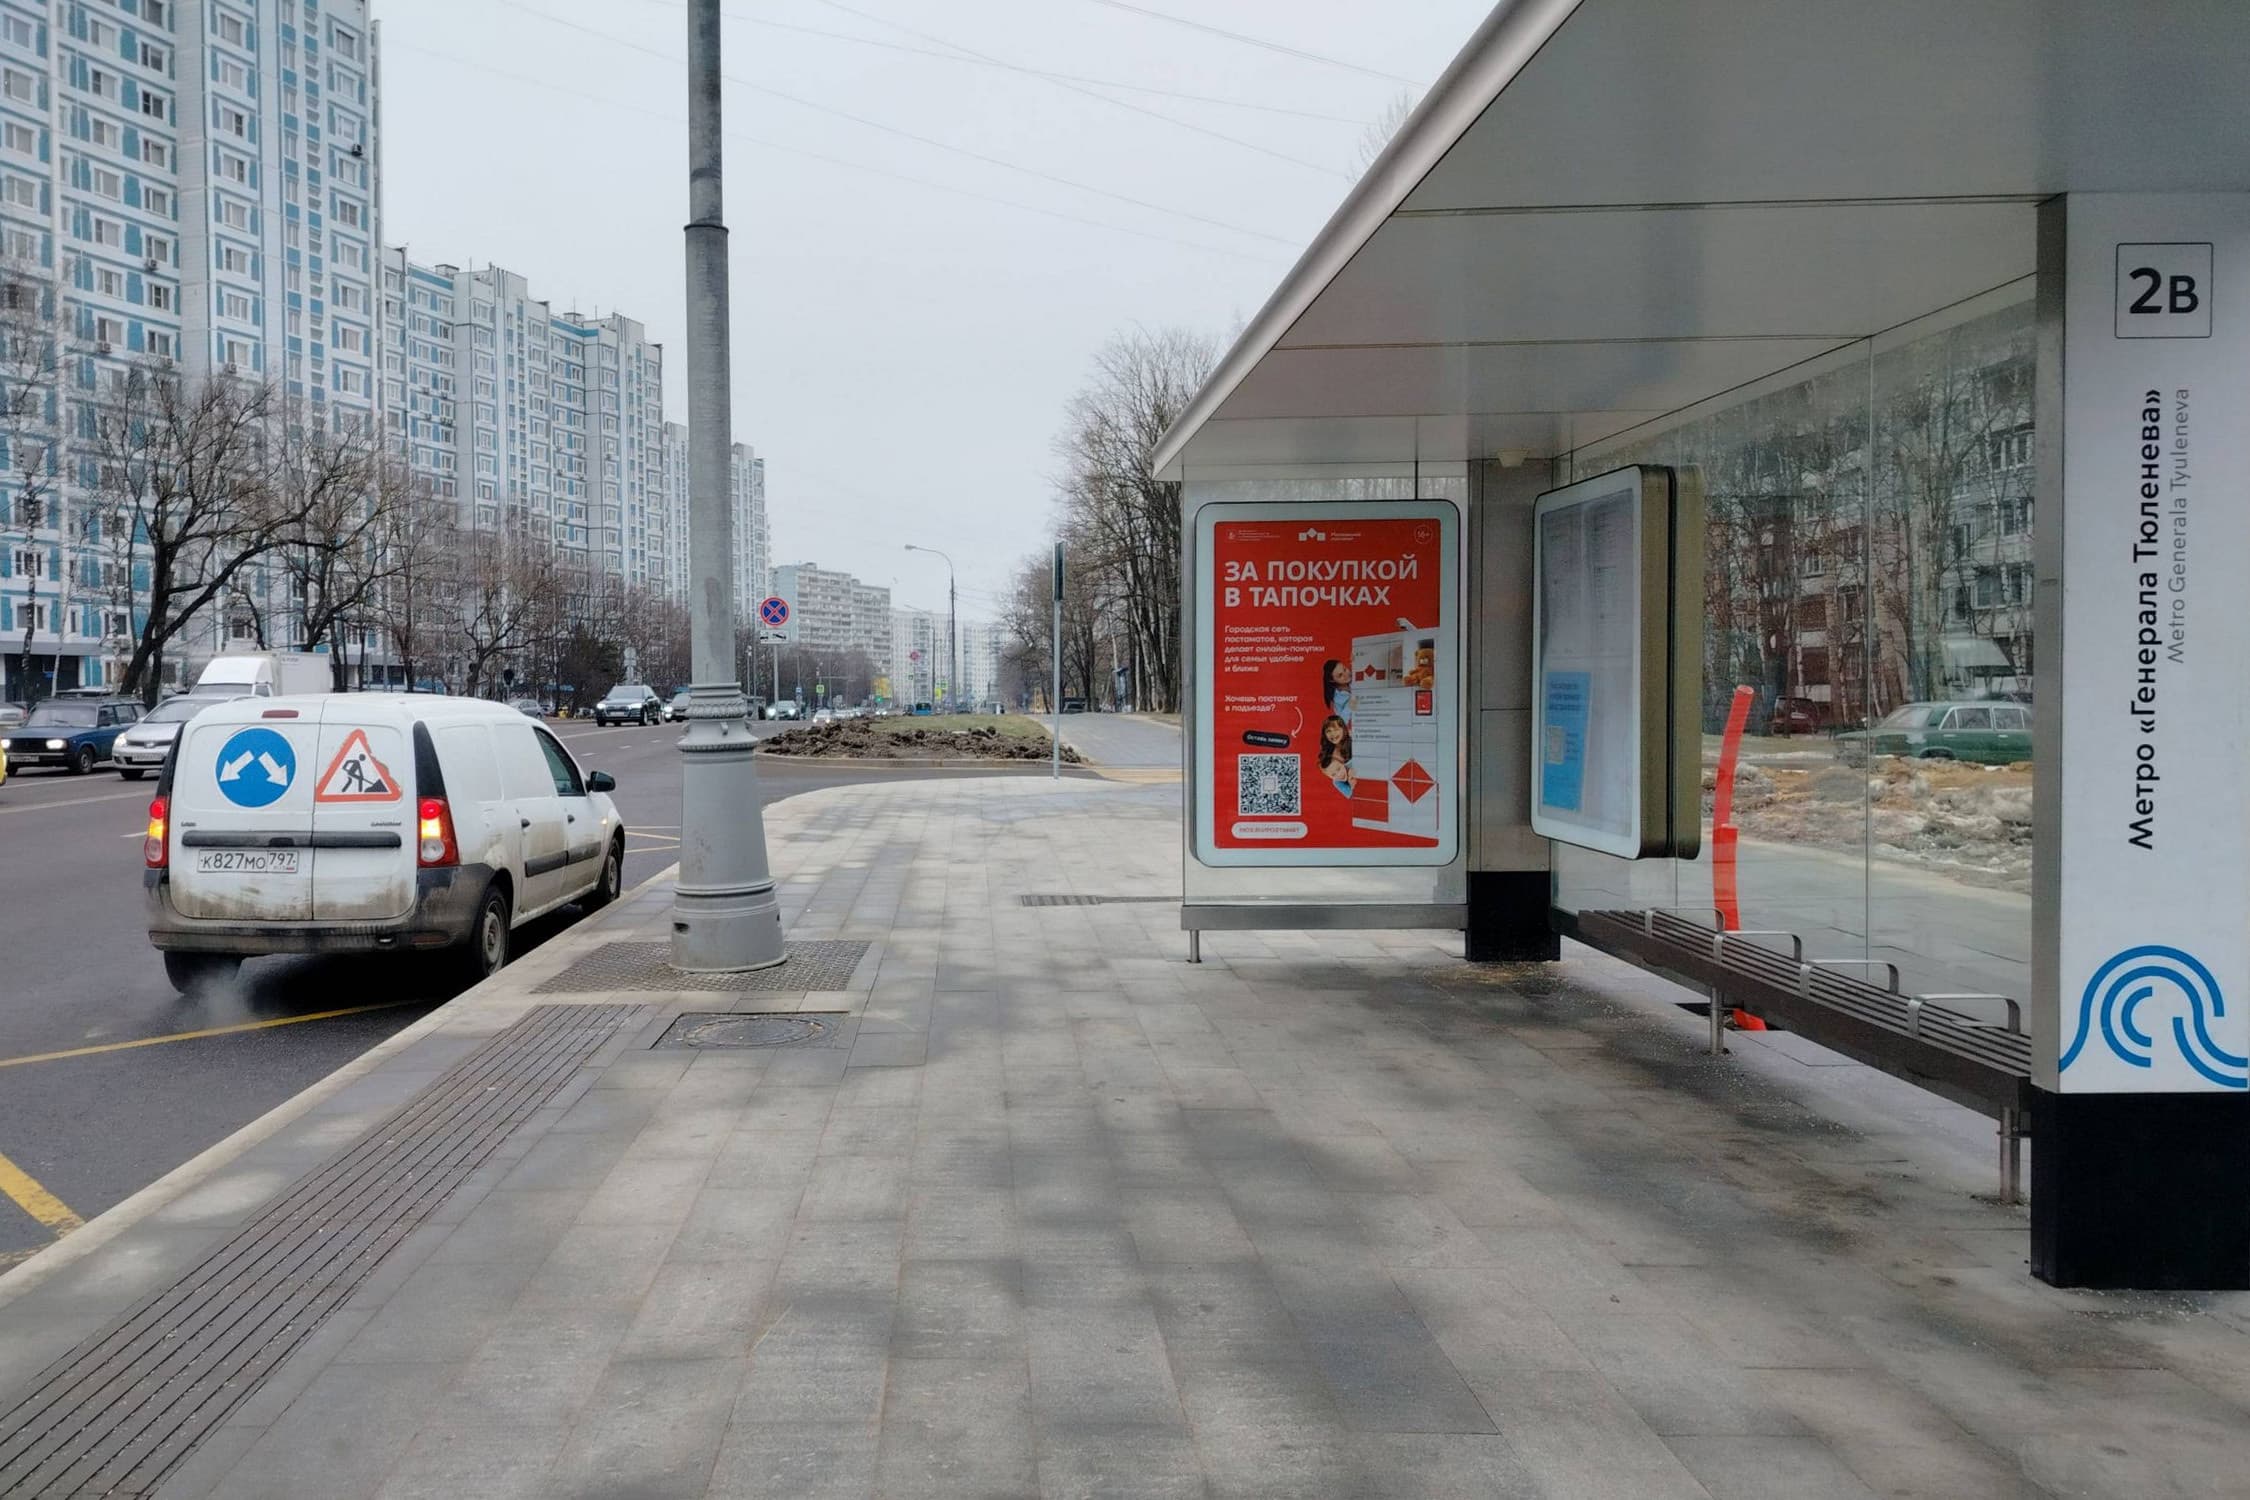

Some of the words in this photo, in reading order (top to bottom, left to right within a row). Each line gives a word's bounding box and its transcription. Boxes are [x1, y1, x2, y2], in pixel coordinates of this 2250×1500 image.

[2169, 388, 2191, 493] Tyuleneva
[2133, 389, 2161, 564] Тюленева»
[1224, 561, 1258, 582] ЗА
[1267, 554, 1419, 582] ПОКУПКОЙ
[2168, 497, 2187, 593] Generala
[1224, 587, 1241, 608] В
[1248, 585, 1391, 607] ТАПОЧКАХ
[1224, 625, 1270, 634] Городская
[1224, 636, 1277, 644] постаматов,
[2131, 572, 2163, 733] «Генерала
[2167, 598, 2185, 664] Metro
[2128, 744, 2160, 850] Метро
[269, 852, 295, 866] 797
